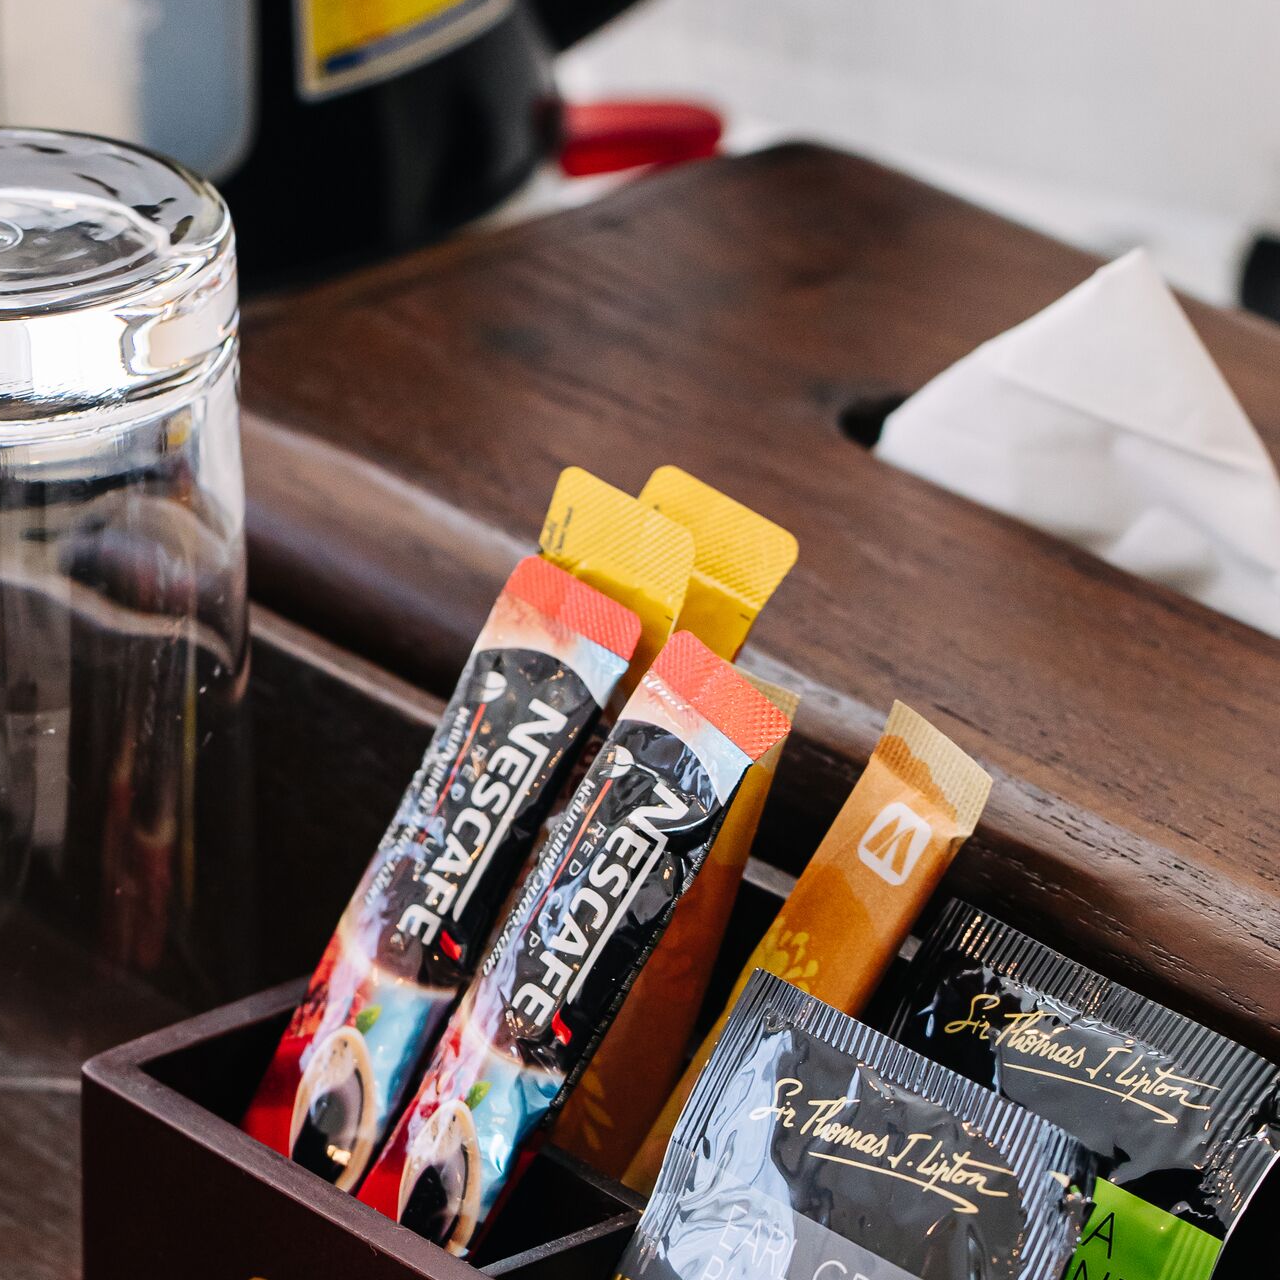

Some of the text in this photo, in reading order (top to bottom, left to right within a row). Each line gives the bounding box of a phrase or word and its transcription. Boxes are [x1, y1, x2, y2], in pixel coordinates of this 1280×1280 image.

[528, 820, 608, 950] RED CUP
[944, 993, 1001, 1041] Sir
[995, 1009, 1086, 1069] Thomas
[1114, 1054, 1222, 1110] Lipton
[748, 1077, 804, 1129] Sir
[799, 1096, 890, 1158] Thomas
[916, 1140, 1019, 1198] Lipton
